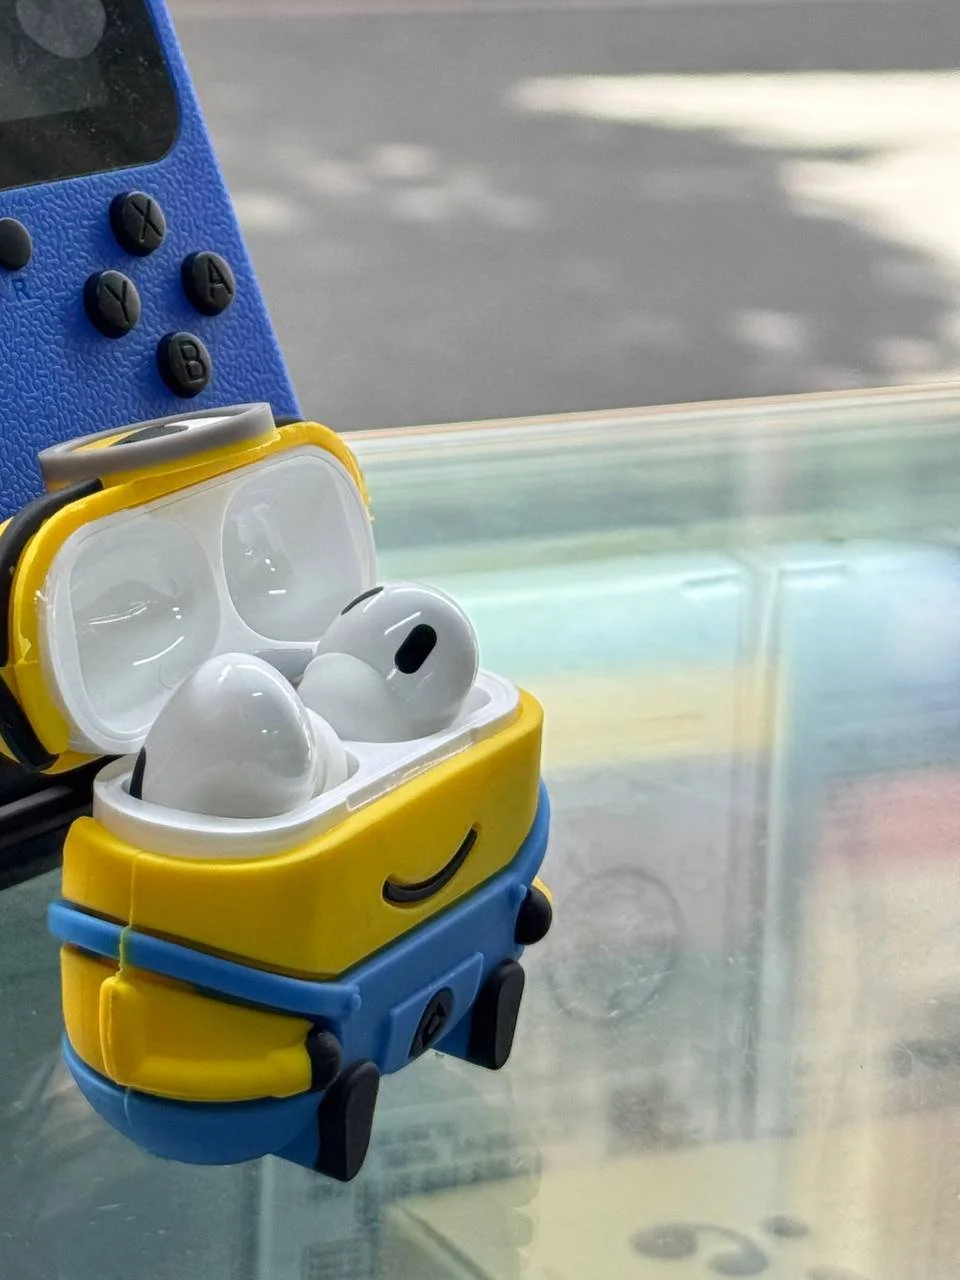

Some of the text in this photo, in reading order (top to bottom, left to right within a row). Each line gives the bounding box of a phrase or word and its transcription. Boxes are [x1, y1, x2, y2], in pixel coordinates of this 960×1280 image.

[130, 198, 164, 242] X
[11, 279, 32, 301] R
[207, 256, 233, 301] A
[103, 279, 131, 326] Y
[178, 339, 207, 384] B
